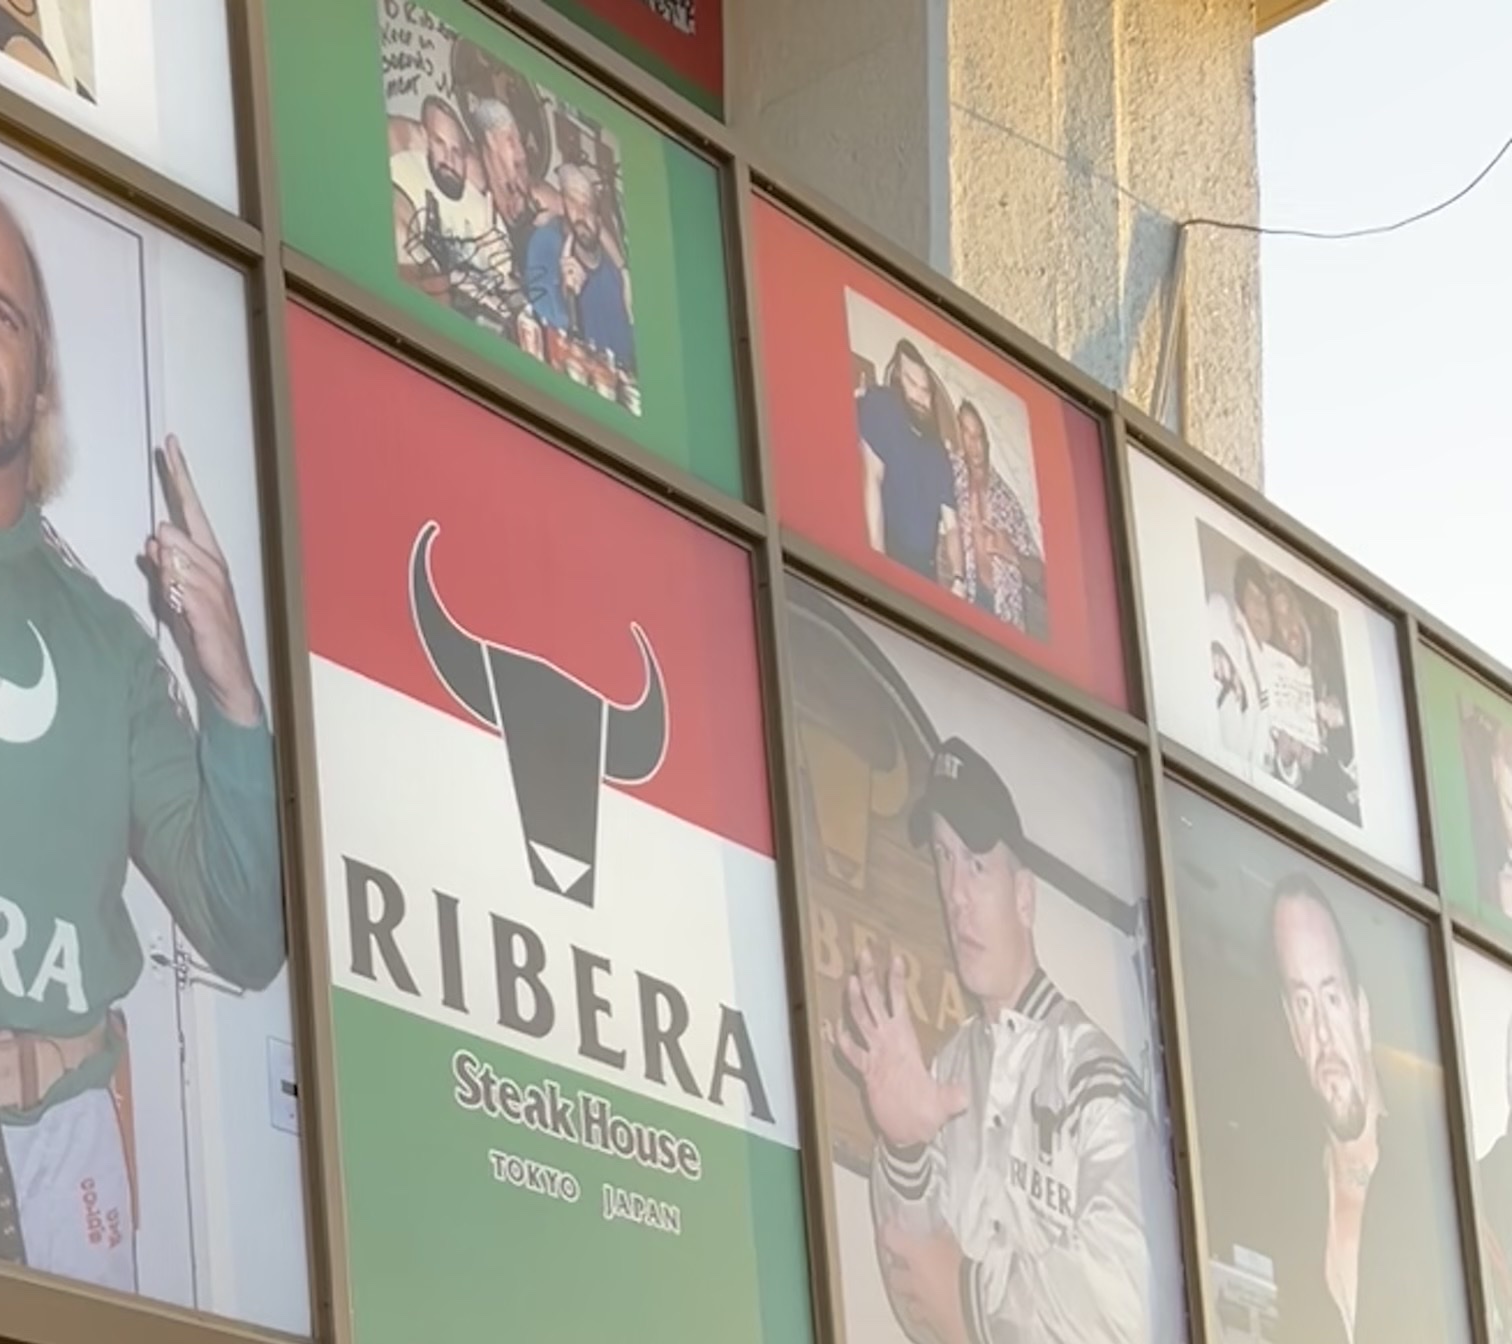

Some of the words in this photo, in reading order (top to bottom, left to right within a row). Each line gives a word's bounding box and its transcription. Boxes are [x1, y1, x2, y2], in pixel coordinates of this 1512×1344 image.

[341, 855, 777, 1125] RIBERA
[489, 1149, 581, 1202] TOKYO
[602, 1184, 681, 1233] JAPAN
[1009, 1155, 1075, 1218] RIBER
